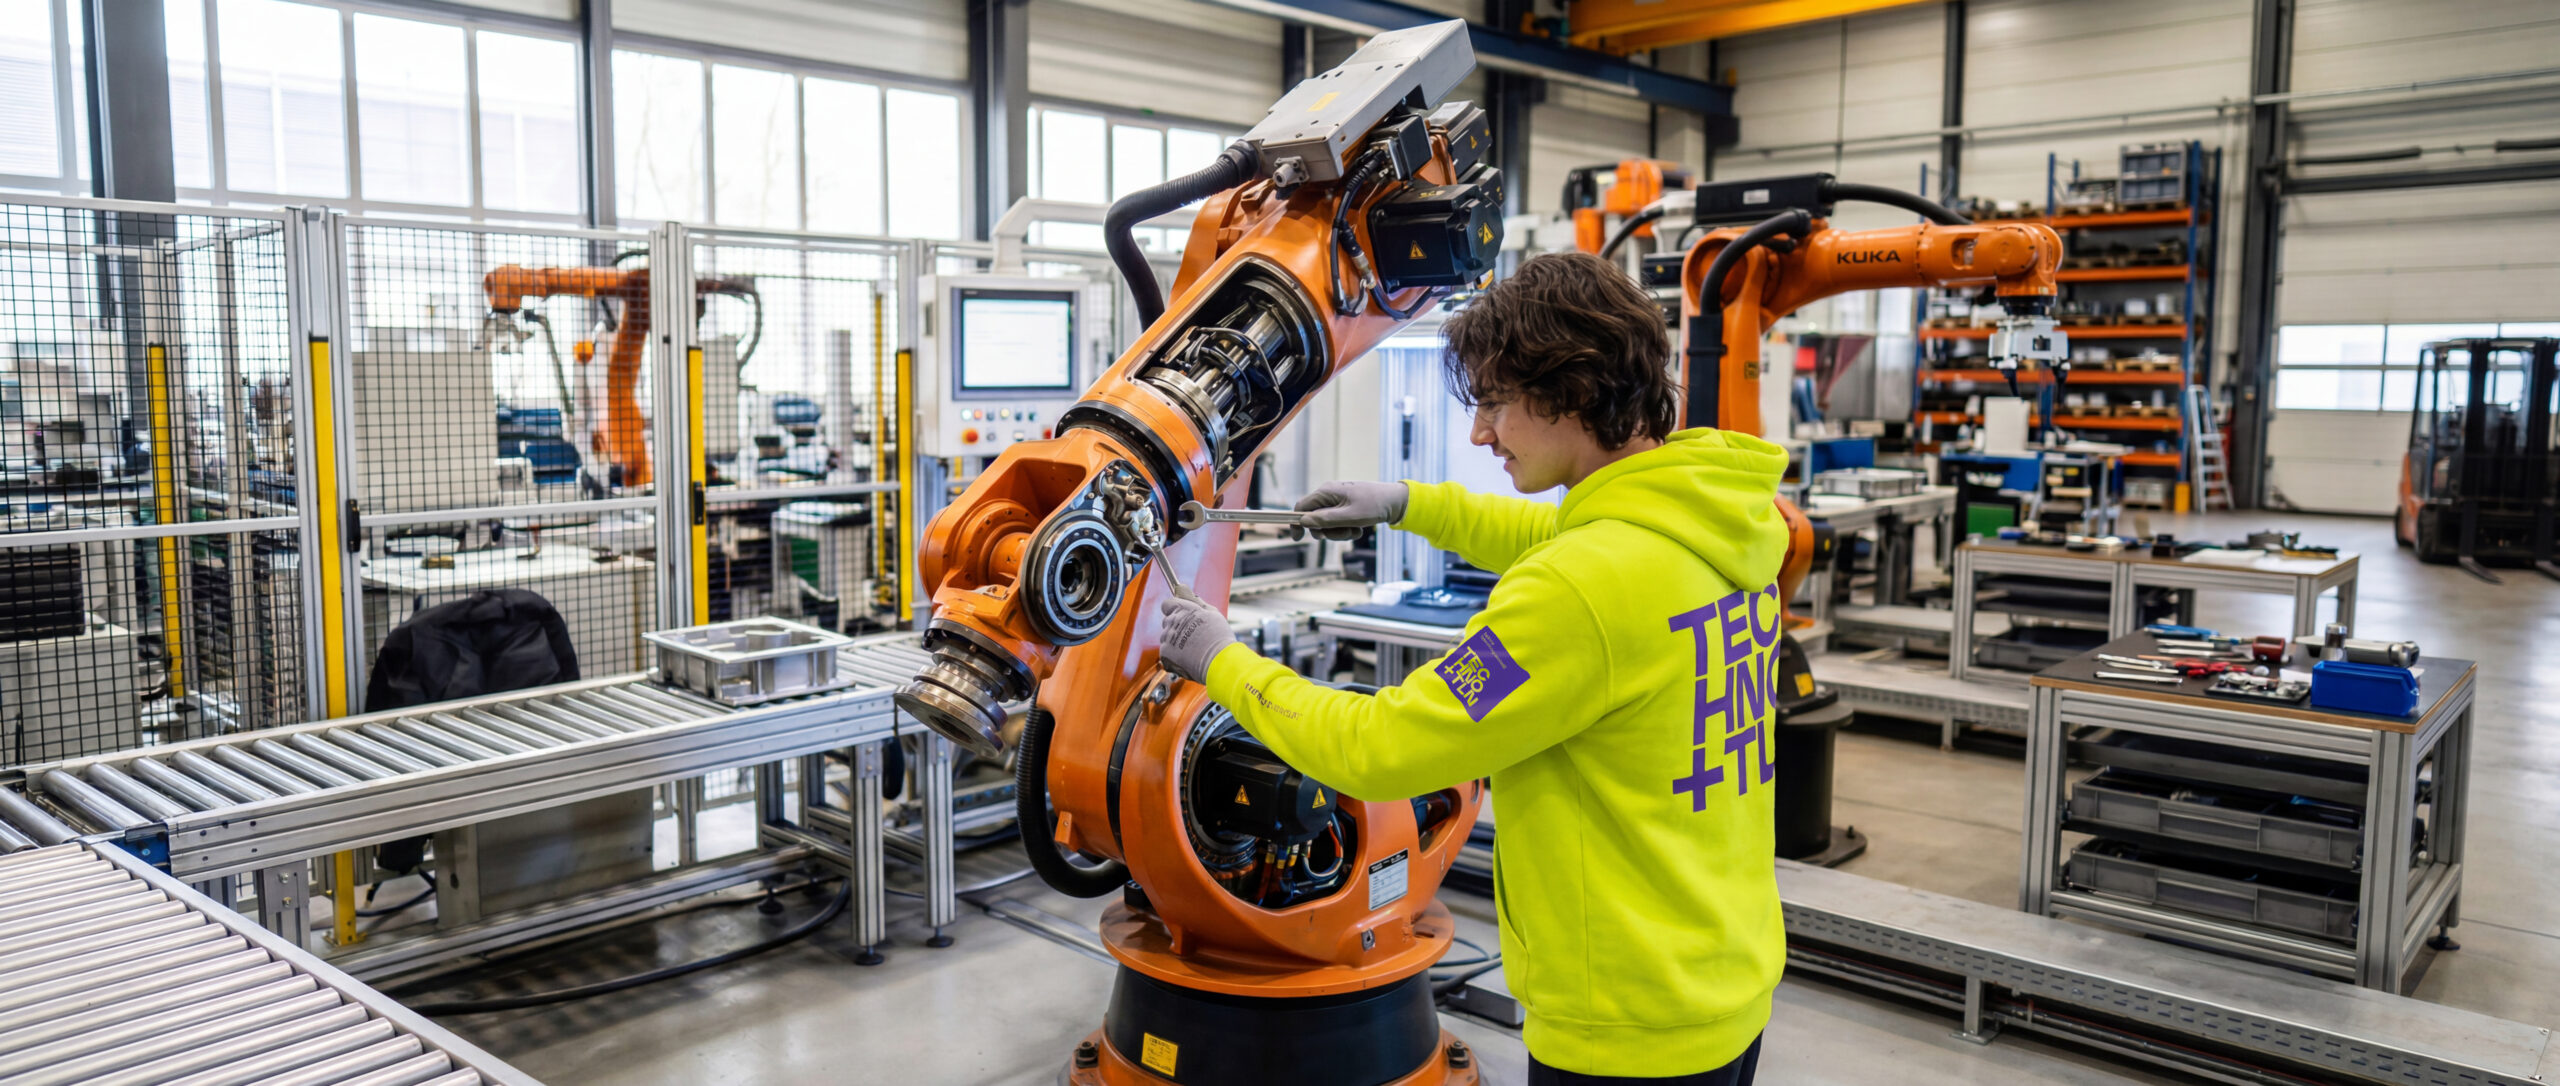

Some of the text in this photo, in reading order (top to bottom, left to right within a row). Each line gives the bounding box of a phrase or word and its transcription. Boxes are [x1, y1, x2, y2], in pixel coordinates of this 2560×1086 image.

[1837, 249, 1901, 265] KUKA
[1668, 583, 1780, 678] TEC
[1453, 657, 1484, 693] HNO
[1462, 645, 1491, 682] TEC
